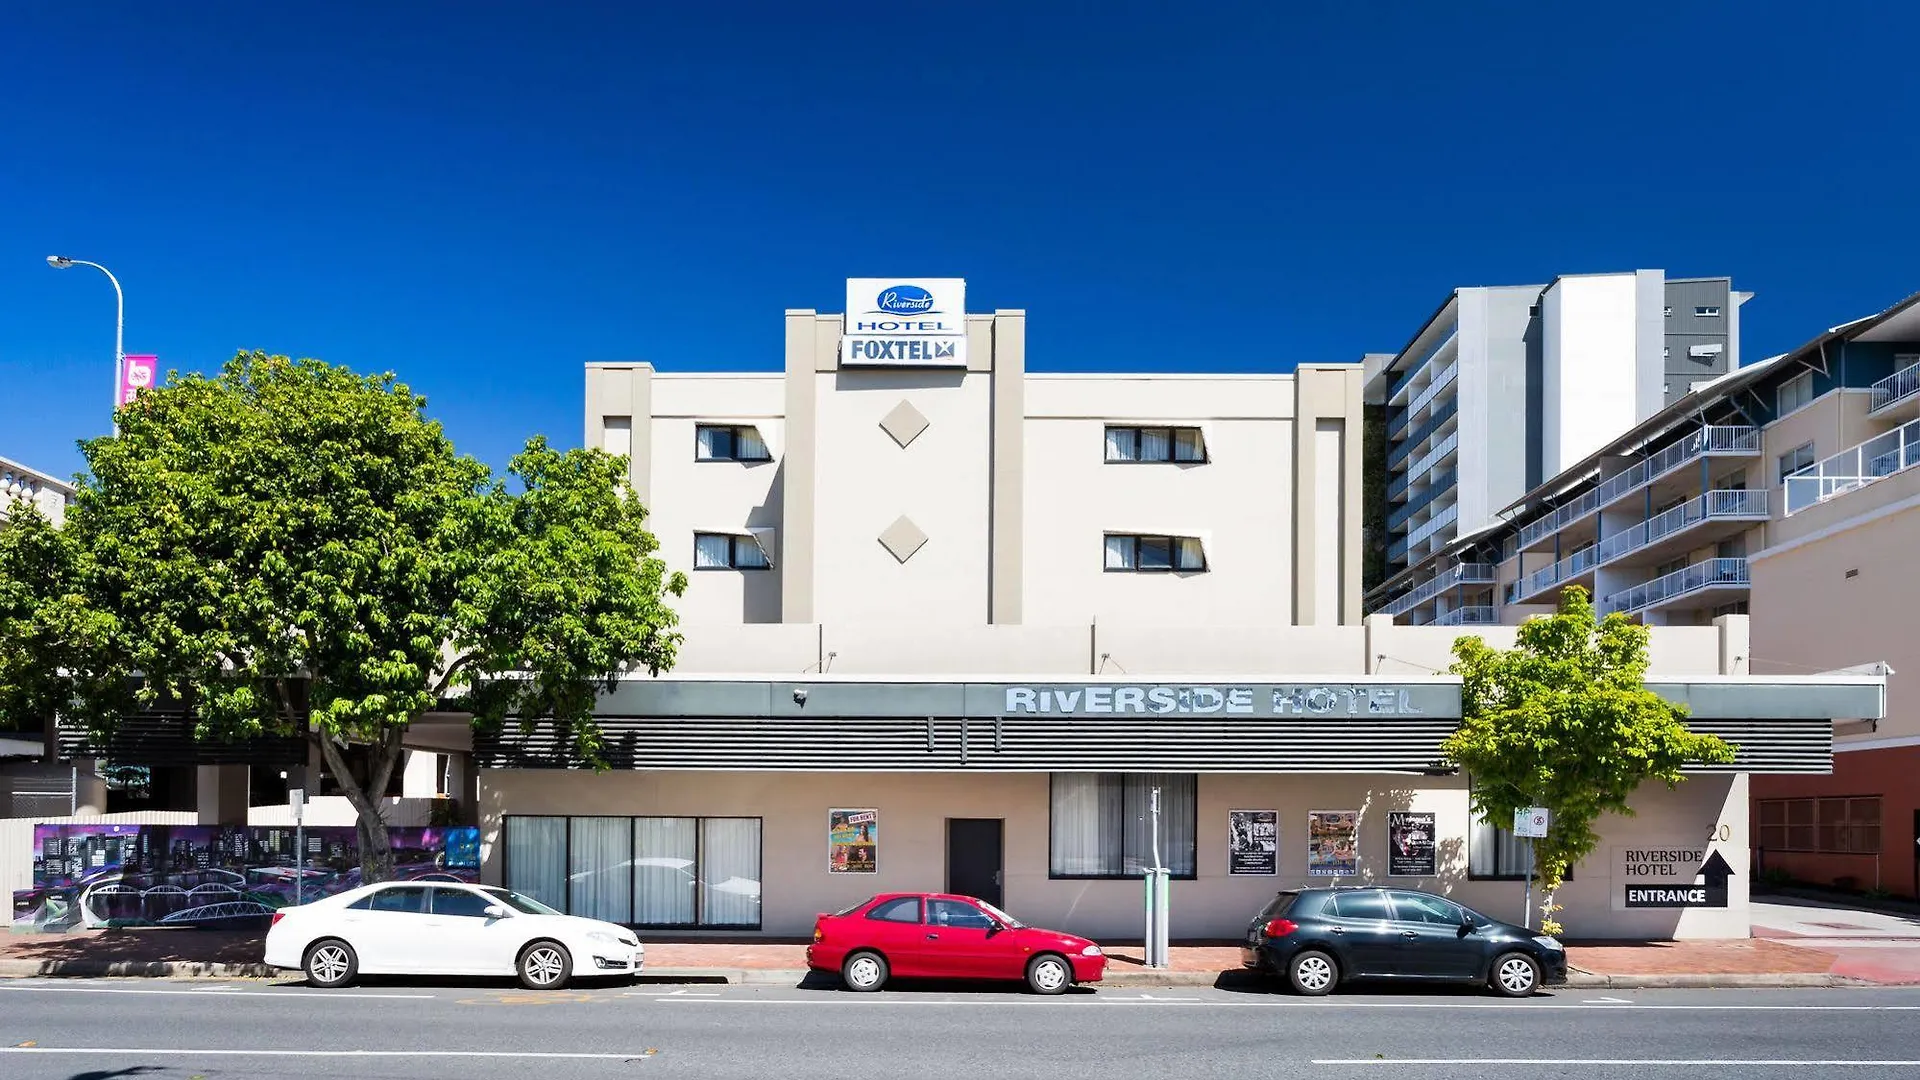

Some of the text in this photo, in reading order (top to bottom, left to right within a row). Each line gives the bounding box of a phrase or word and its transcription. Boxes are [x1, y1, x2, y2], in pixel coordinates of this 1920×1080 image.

[881, 291, 932, 309] Riverside
[858, 322, 953, 330] HOTEL
[851, 340, 933, 360] FOXTEL
[1273, 687, 1424, 714] HOTEL
[1706, 824, 1730, 841] 20
[1625, 850, 1703, 862] RIVERSIDE
[1625, 864, 1677, 876] HOTEL
[1628, 889, 1706, 902] ENTRANCE
